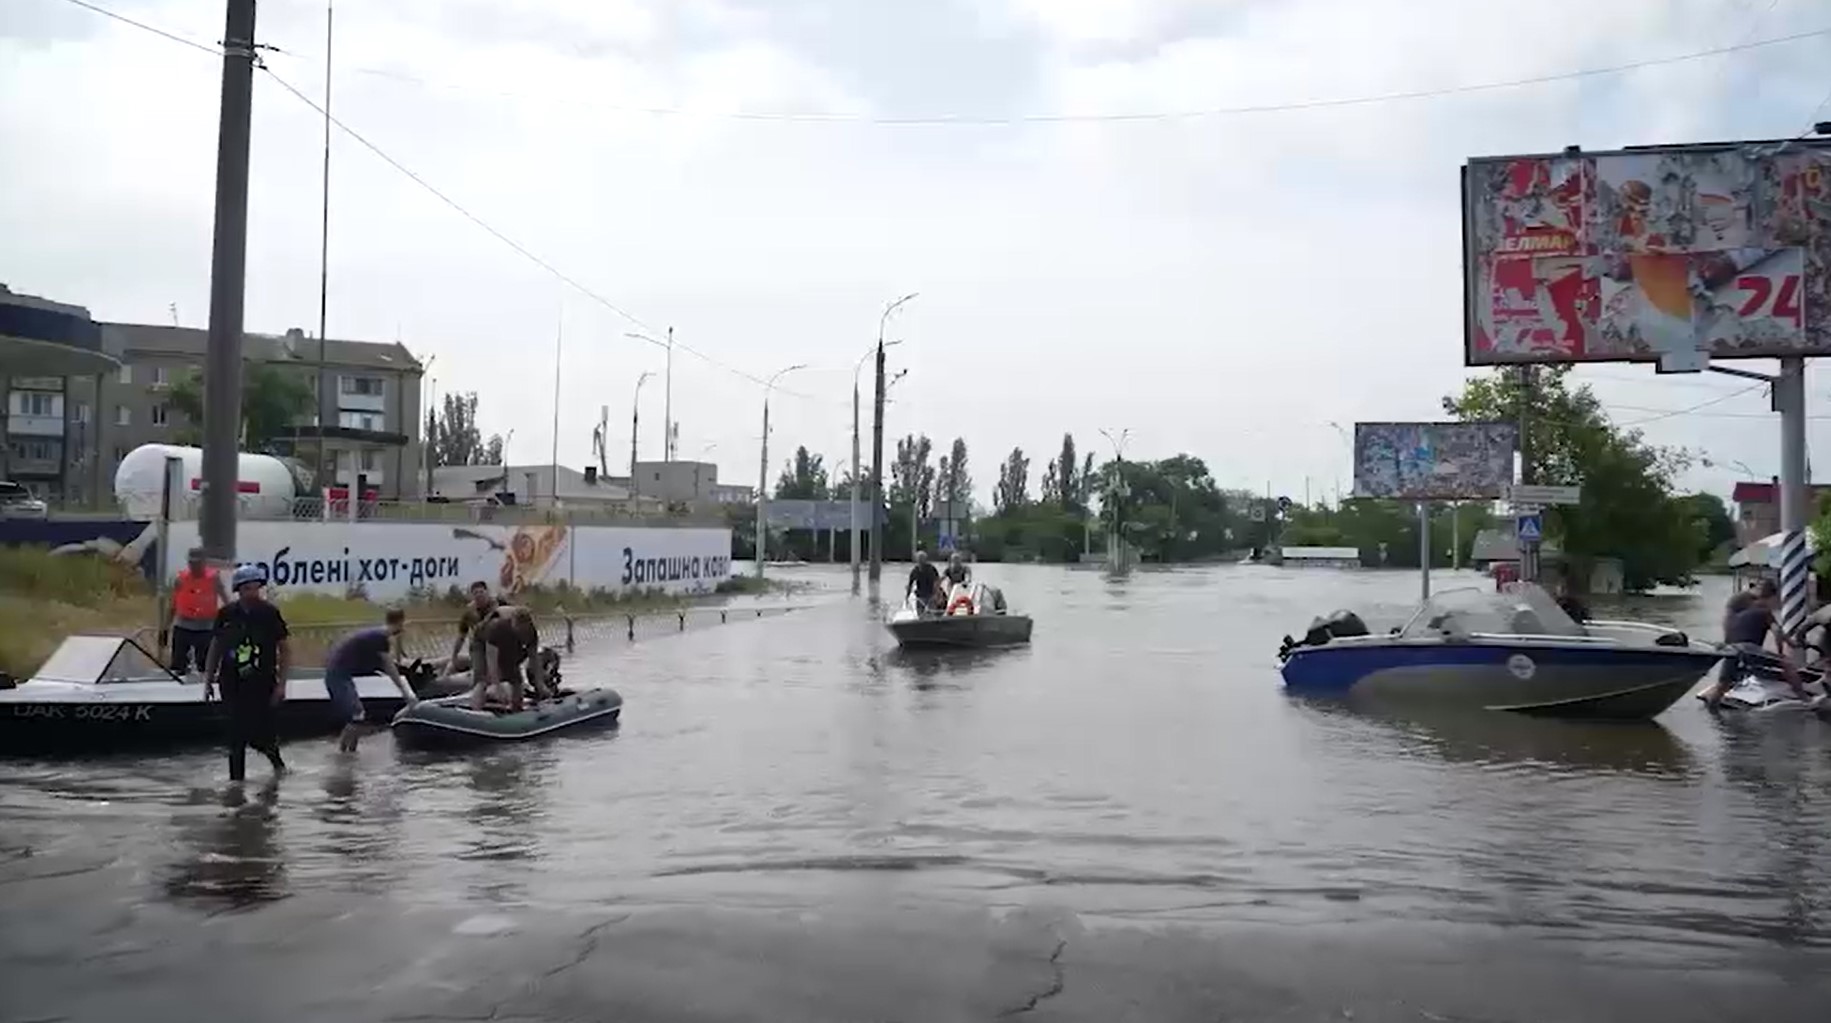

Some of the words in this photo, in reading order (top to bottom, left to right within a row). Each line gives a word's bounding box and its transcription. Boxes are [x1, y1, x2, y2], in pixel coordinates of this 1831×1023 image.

[358, 557, 459, 586] хот-доги
[621, 547, 700, 585] Запашна
[75, 704, 130, 720] 5024
[135, 705, 156, 721] K
